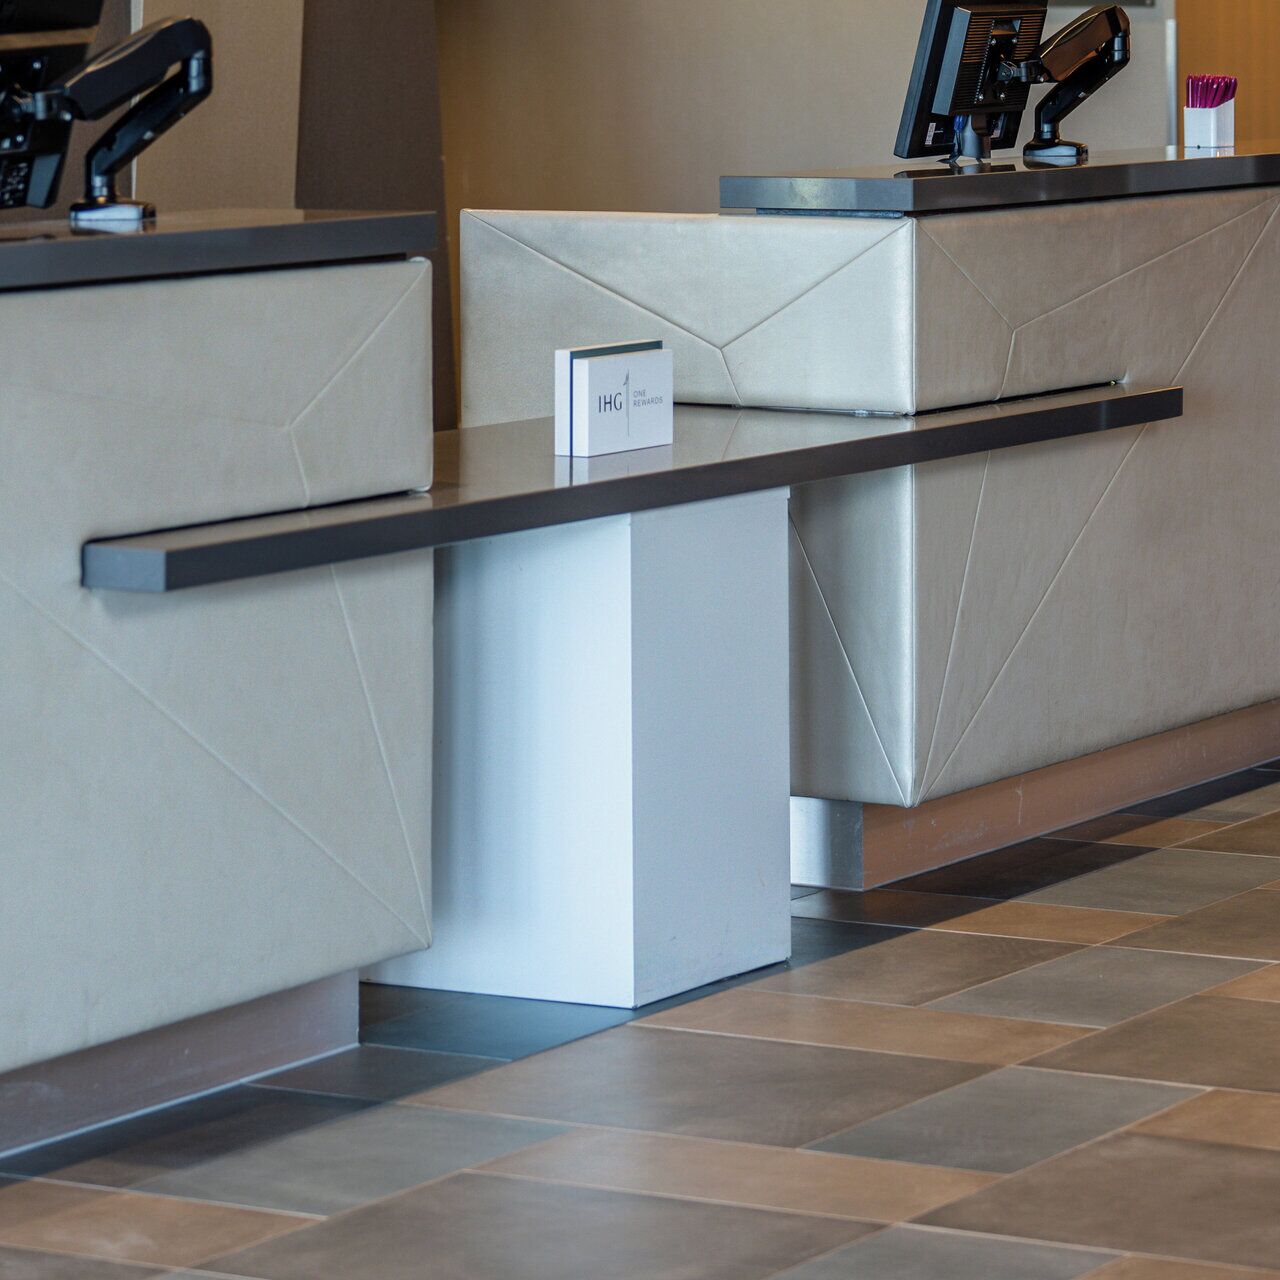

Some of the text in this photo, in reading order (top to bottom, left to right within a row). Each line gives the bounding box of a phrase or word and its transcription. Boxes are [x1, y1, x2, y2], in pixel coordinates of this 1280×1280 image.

[633, 389, 646, 398] ONE
[599, 393, 622, 413] IHG
[633, 396, 663, 407] REWARDS
